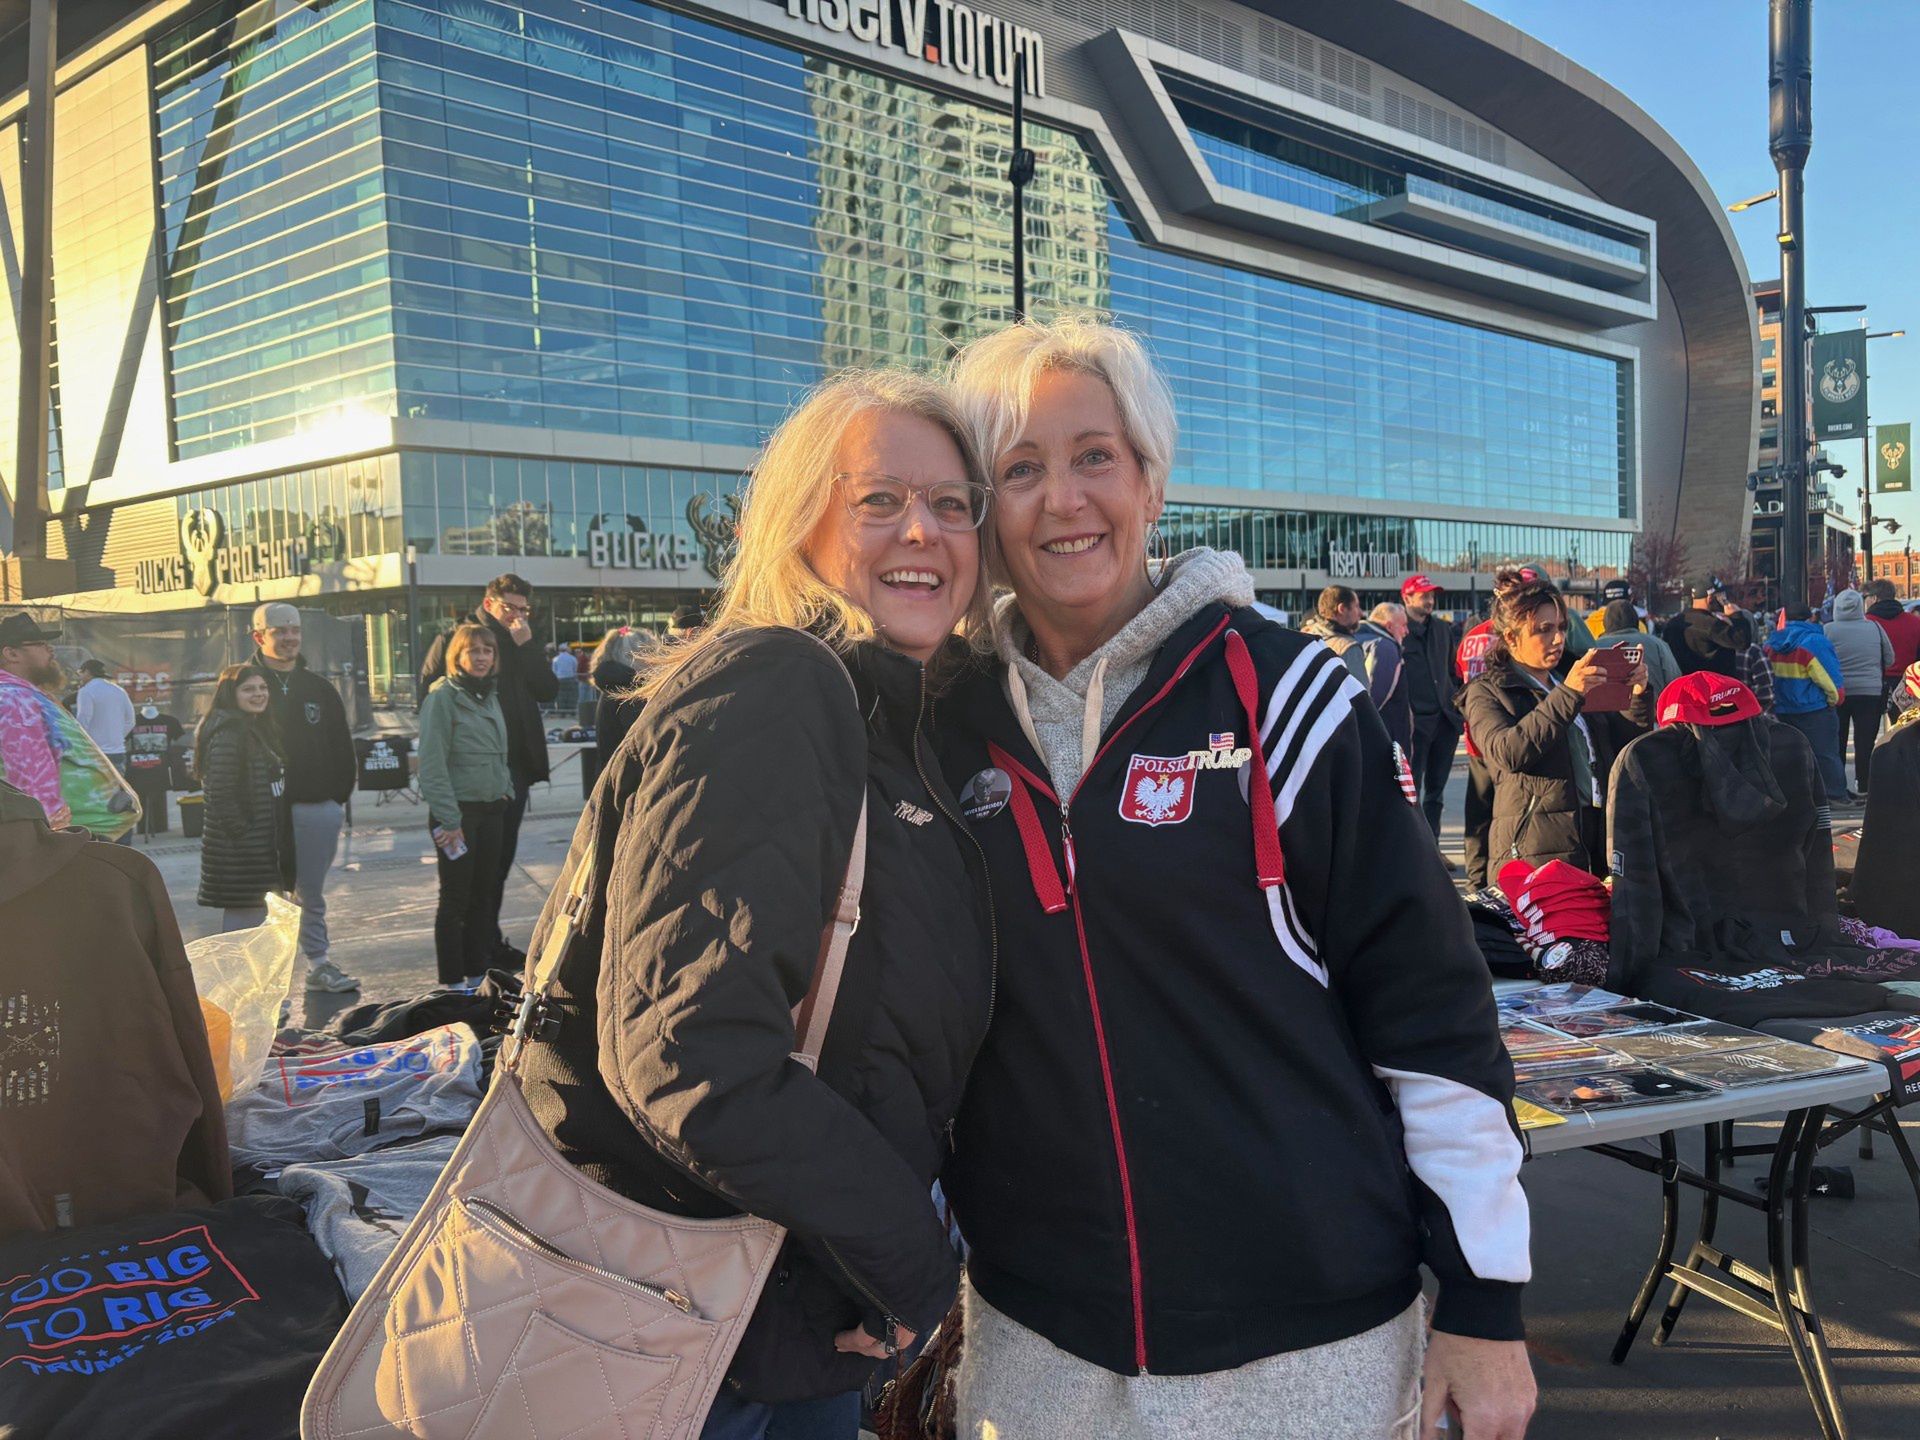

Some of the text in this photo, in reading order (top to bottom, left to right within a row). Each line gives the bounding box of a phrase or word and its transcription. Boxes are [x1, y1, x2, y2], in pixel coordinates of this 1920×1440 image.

[786, 0, 1046, 97] erv.forum
[134, 536, 308, 595] BUCKS PRO SHOP
[589, 530, 690, 569] BUCKS
[1329, 541, 1400, 577] fiserv.forum
[1710, 687, 1741, 703] TRUMP
[1131, 757, 1191, 773] POLSK
[1187, 748, 1252, 770] TRUMP
[894, 799, 934, 827] TRUMP
[0, 1245, 210, 1303] OO BIG
[5, 1287, 212, 1343] TO RIG
[156, 1310, 236, 1345] 2024
